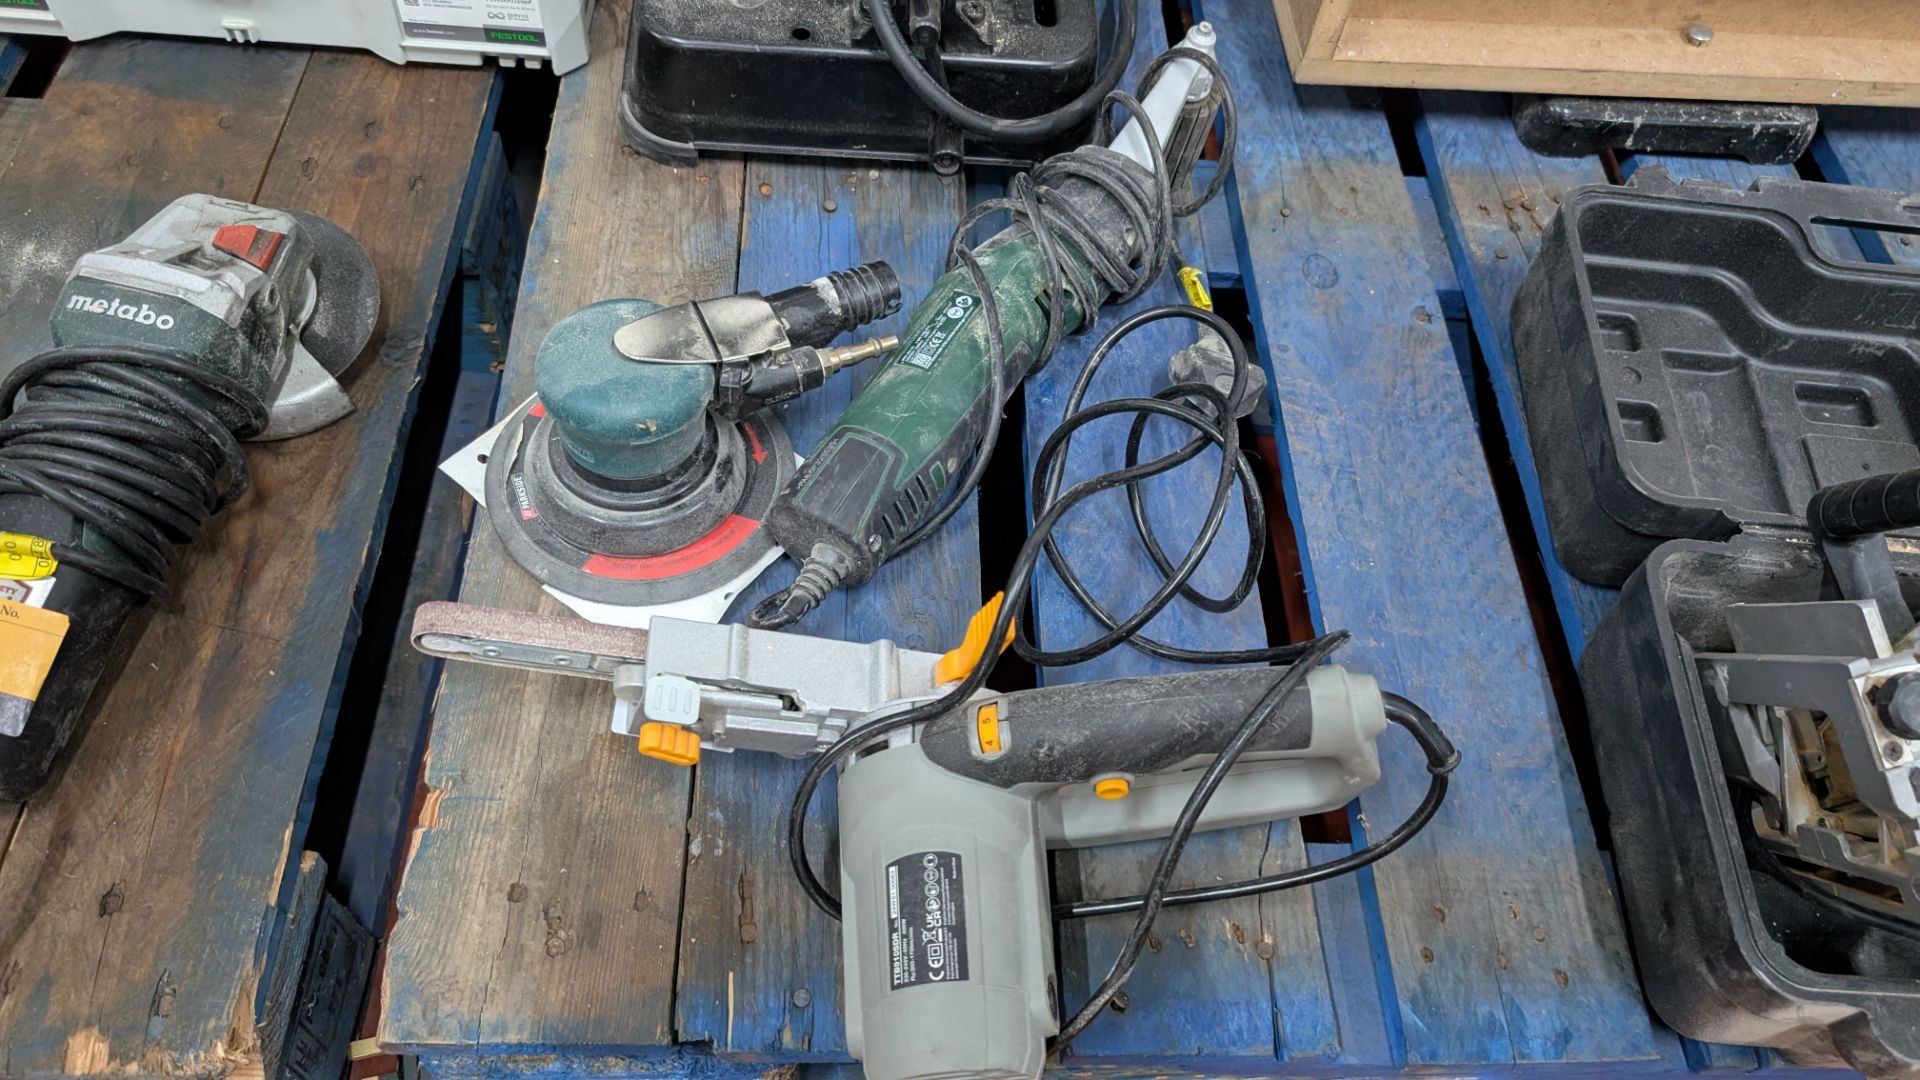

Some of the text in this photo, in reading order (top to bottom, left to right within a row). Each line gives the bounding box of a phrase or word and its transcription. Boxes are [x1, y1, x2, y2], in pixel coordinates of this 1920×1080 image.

[490, 32, 540, 42] FESTOOL
[67, 295, 174, 330] metabo
[514, 476, 529, 509] PARKSIDE
[0, 605, 20, 619] No.
[926, 913, 935, 928] UK
